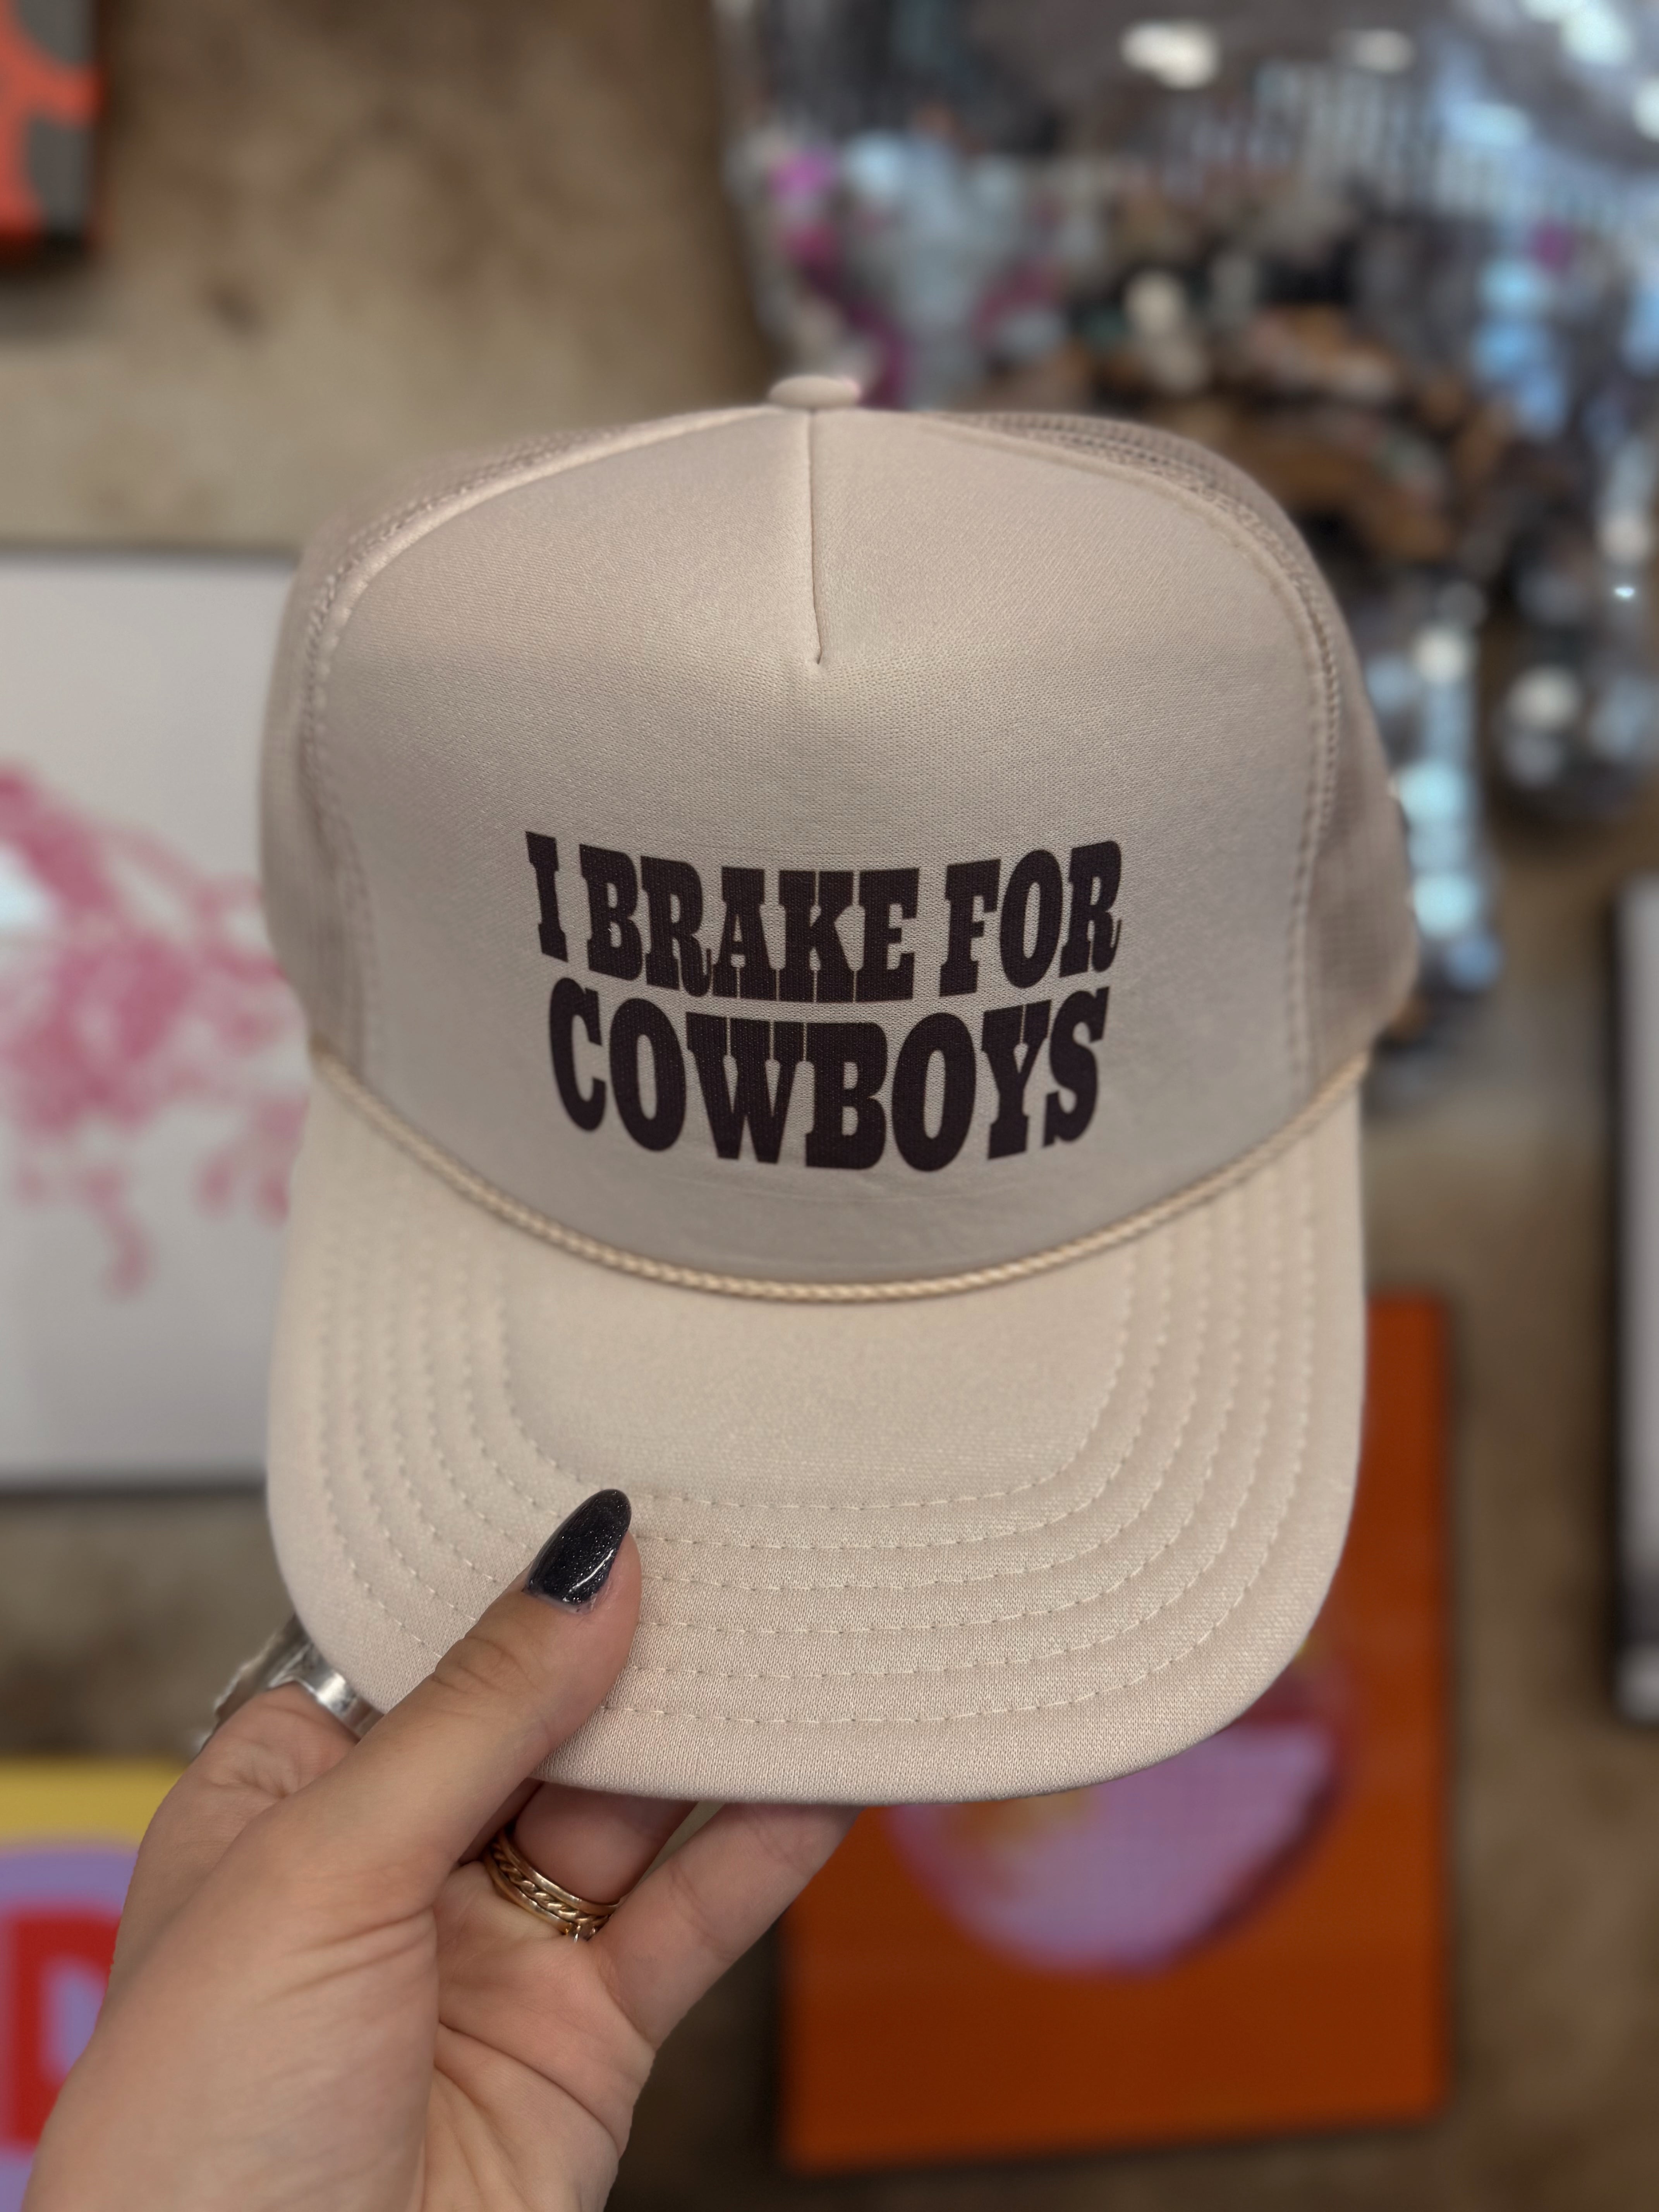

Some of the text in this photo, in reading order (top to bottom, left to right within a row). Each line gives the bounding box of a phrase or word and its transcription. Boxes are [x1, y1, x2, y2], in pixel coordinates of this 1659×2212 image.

[525, 831, 1122, 1004] I BRAKE FOR
[548, 976, 1110, 1173] COWBOYS
